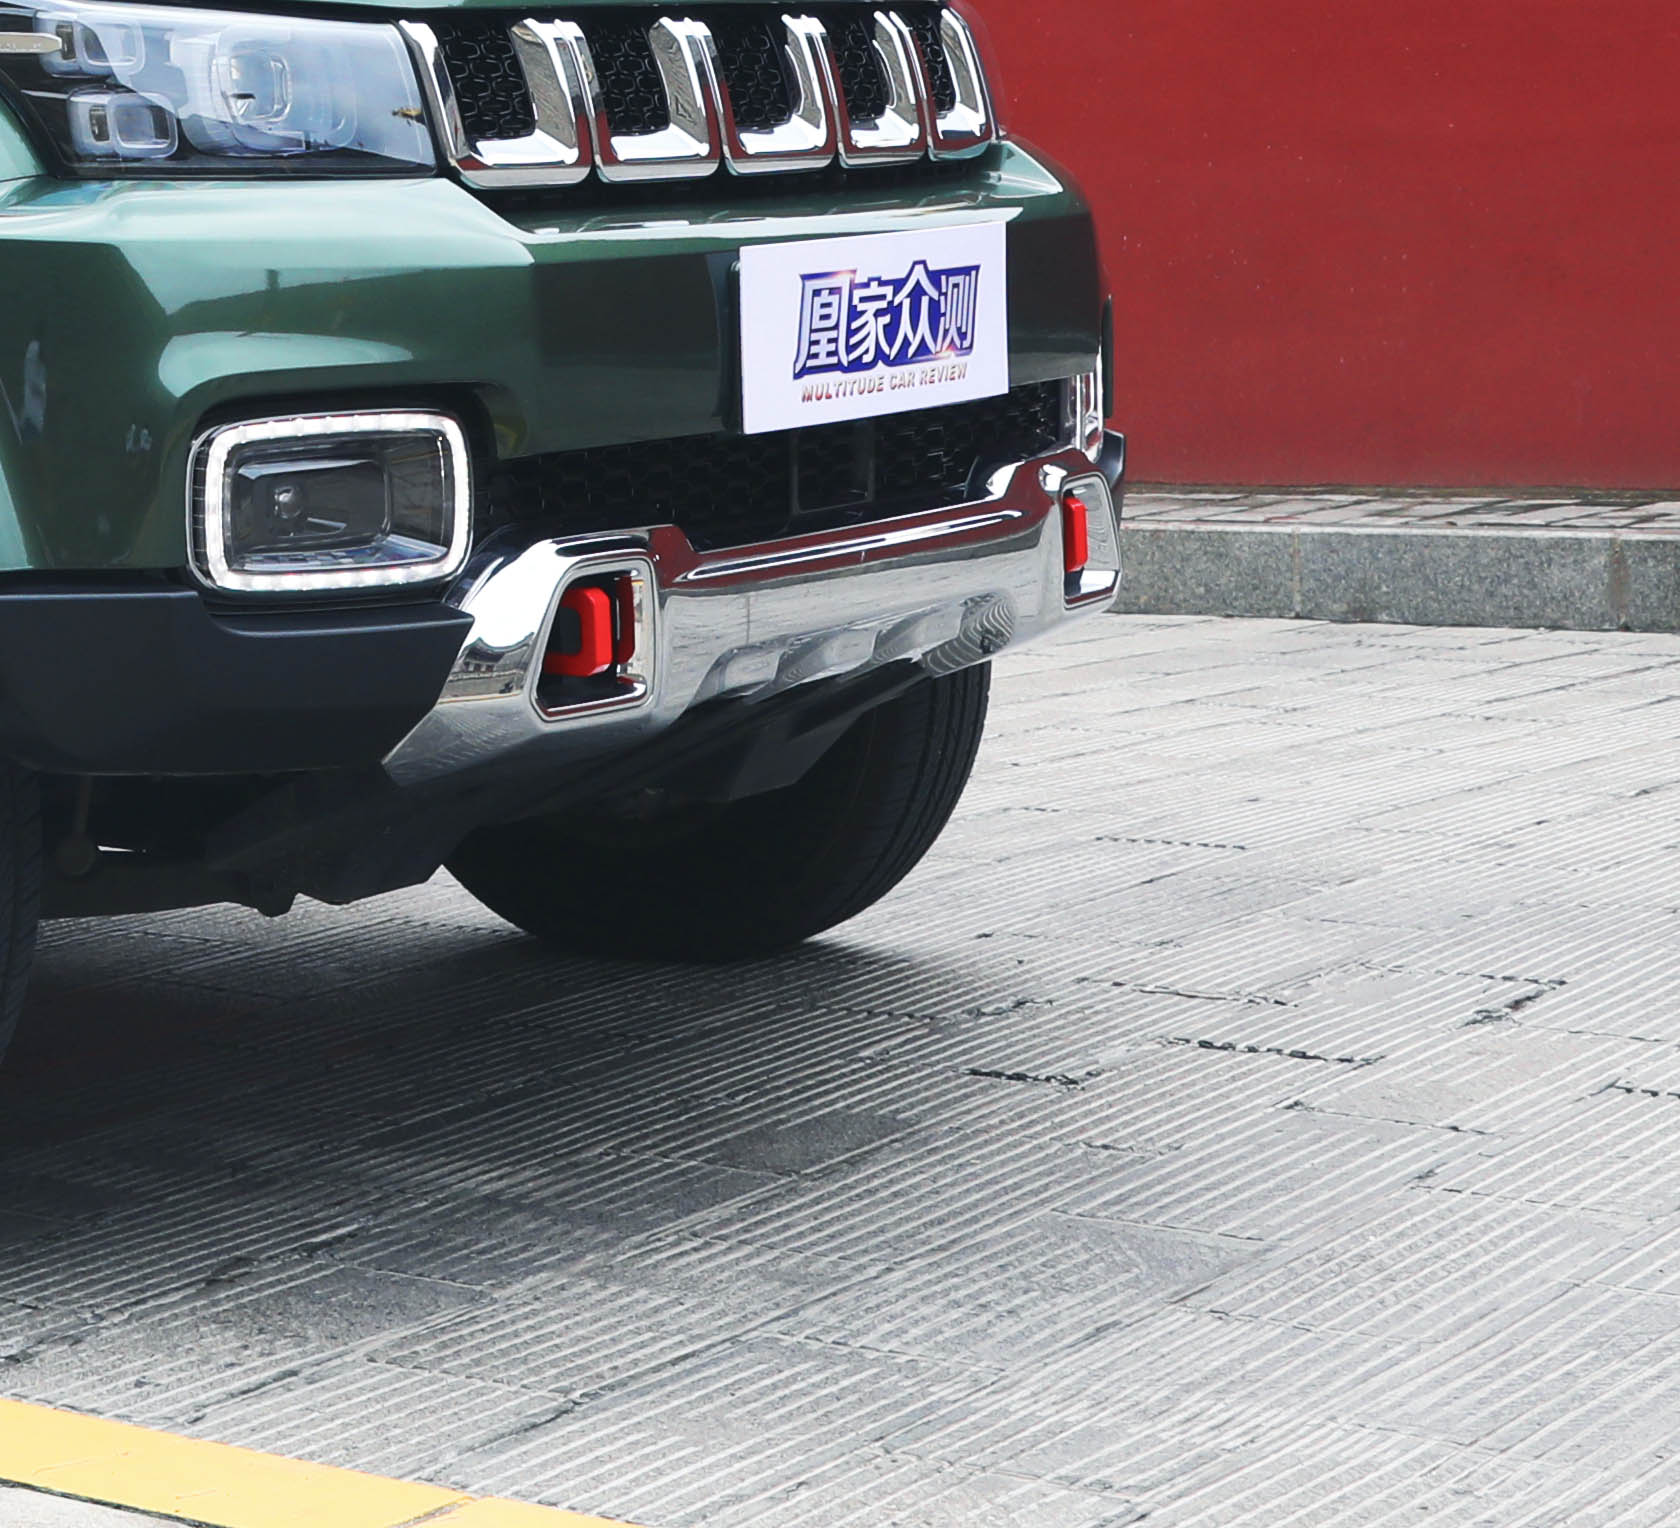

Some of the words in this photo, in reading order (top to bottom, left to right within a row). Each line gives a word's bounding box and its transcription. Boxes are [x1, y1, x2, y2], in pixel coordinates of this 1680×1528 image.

[794, 261, 980, 378] 凰家众测
[801, 376, 885, 403] MULTITUDE
[889, 372, 916, 391] CAR
[919, 362, 968, 386] REVIEW
